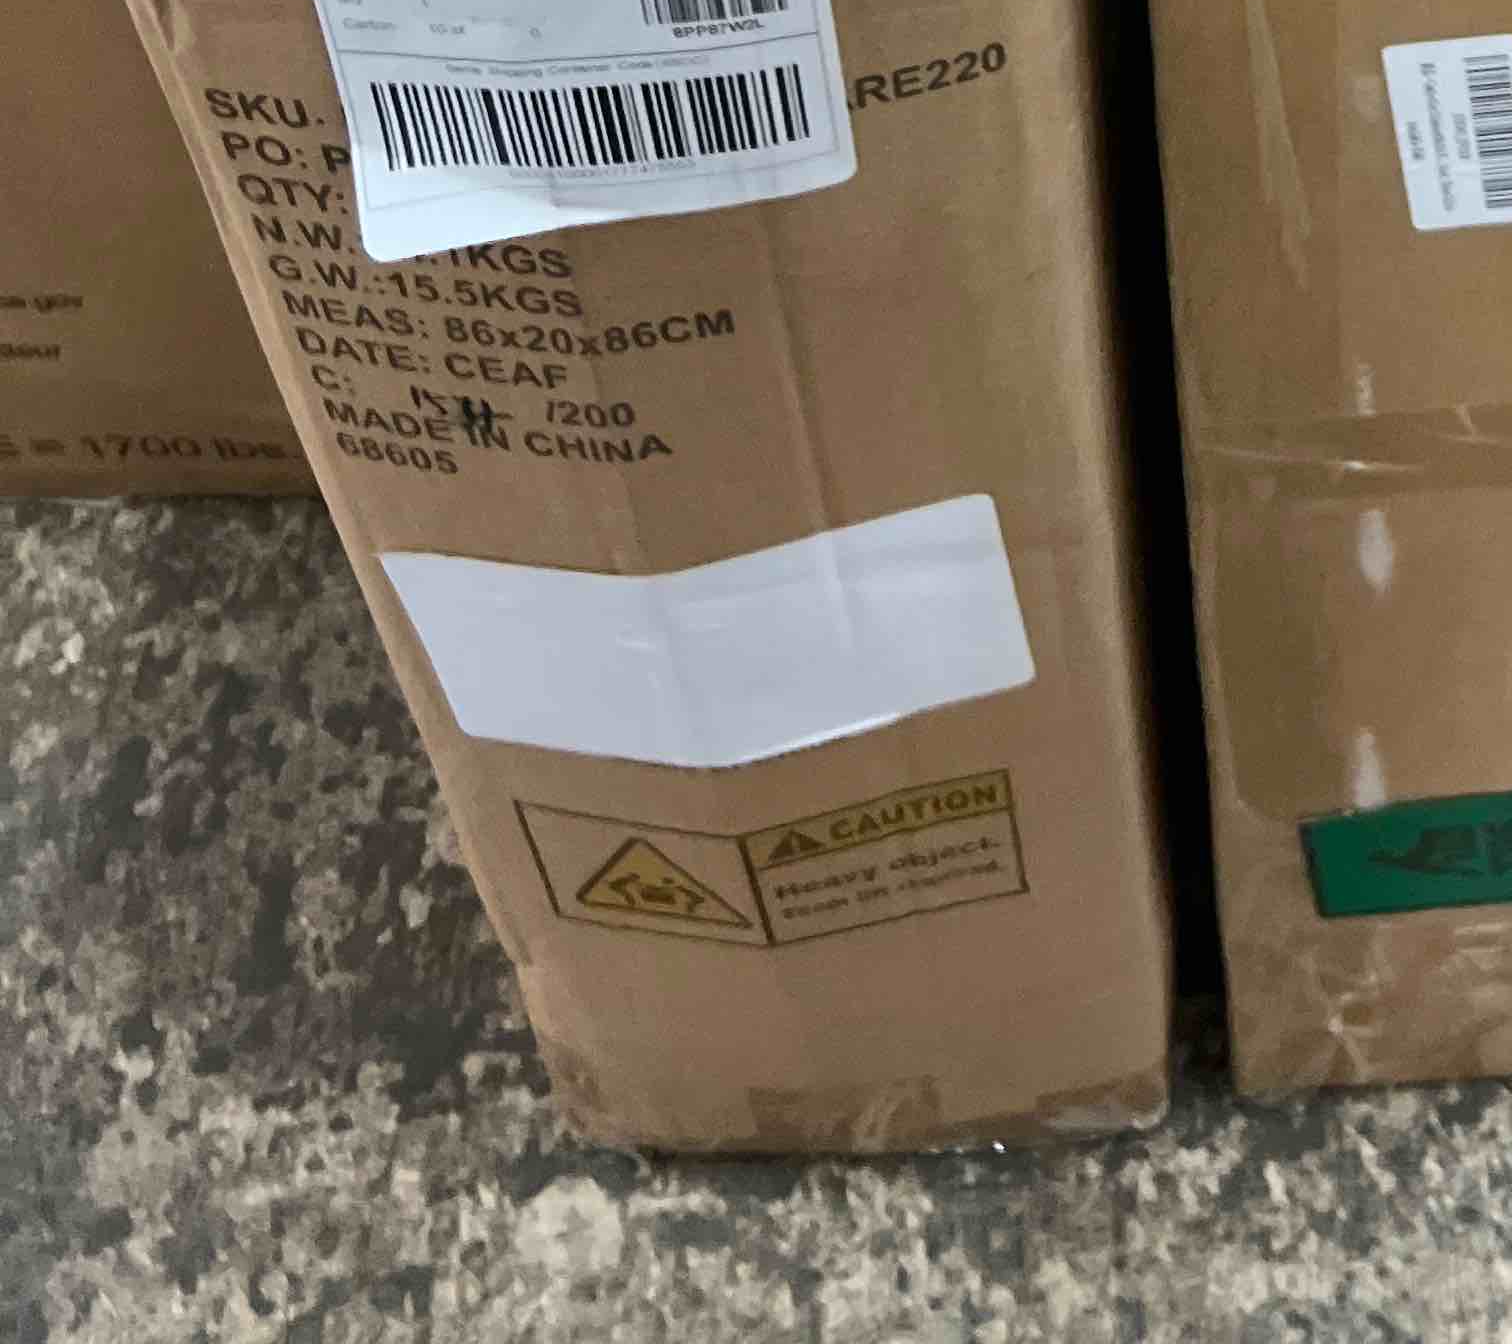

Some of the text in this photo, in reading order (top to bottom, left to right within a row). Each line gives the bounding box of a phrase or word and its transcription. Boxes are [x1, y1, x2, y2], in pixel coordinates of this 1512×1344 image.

[848, 41, 1006, 111] RE220
[221, 131, 308, 170] PO:
[238, 173, 349, 215] QTY:
[282, 289, 736, 356] MEAS: 86x20x86CM
[295, 326, 569, 389] DATE: CEAF
[325, 398, 454, 443] MADE
[464, 424, 511, 452] IN
[524, 433, 673, 464] CHINA
[335, 431, 459, 475] 68605
[828, 782, 998, 843] CAUTION
